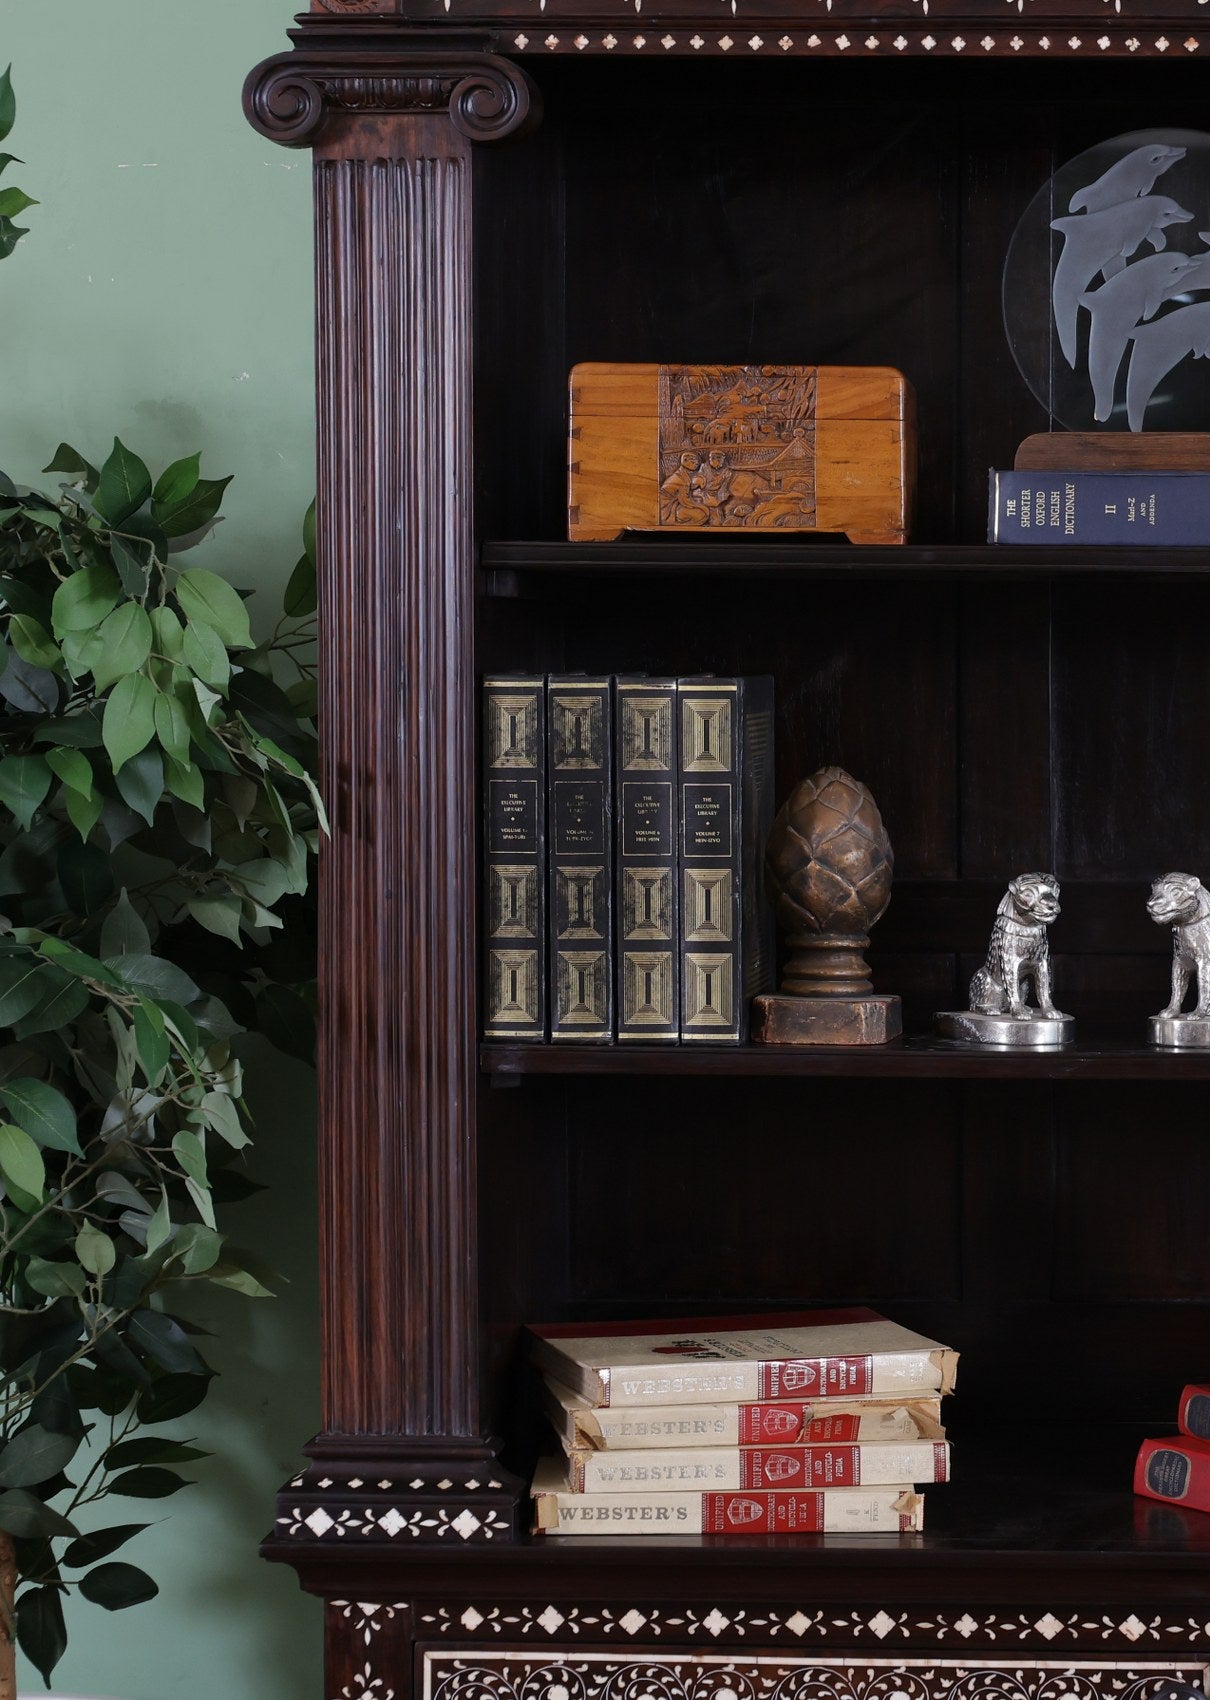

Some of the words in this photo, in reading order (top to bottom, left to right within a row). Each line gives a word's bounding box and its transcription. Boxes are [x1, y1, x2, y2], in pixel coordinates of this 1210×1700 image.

[1007, 500, 1016, 516] THE
[1021, 489, 1031, 527] SHORTER
[1036, 492, 1045, 526] OXFORD
[1051, 491, 1060, 526] ENGLISH
[1065, 483, 1074, 534] DICTIONARY
[1105, 505, 1116, 514] II
[621, 1375, 746, 1395] WEBSTER'S
[770, 1363, 779, 1397] UNIFIED
[839, 1361, 847, 1390] ENCYCLO-
[849, 1365, 857, 1385] PEDIA
[600, 1420, 725, 1438] WEBSTER'S
[751, 1407, 760, 1442] UNIFIED
[814, 1421, 822, 1433] AND
[597, 1465, 727, 1481] WEBSTER'S
[753, 1452, 762, 1487] UNIFIED
[814, 1461, 822, 1475] AND
[825, 1452, 833, 1482] ENCYCLO-
[835, 1457, 843, 1477] PEDIA
[559, 1507, 688, 1521] WEBSTER'S
[715, 1496, 724, 1530] UNIFIED
